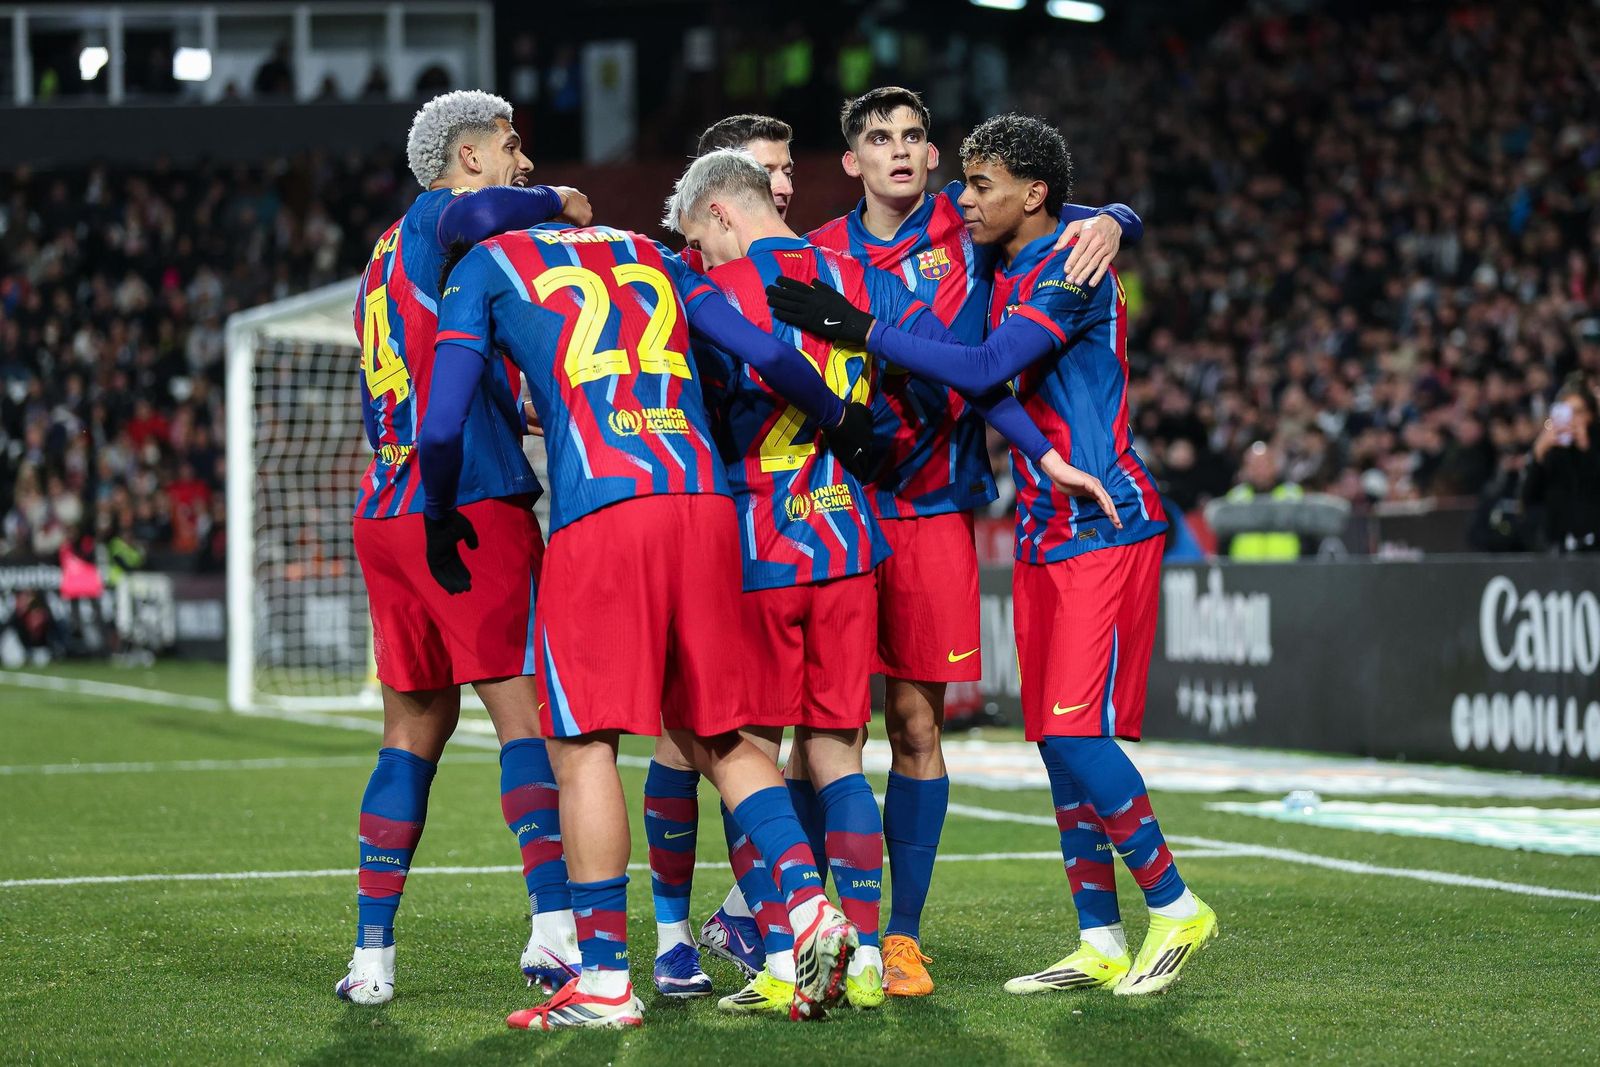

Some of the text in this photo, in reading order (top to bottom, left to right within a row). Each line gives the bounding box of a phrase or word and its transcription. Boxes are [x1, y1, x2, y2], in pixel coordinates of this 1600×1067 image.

[533, 264, 692, 388] 22
[364, 284, 409, 404] 4
[642, 408, 686, 419] UNHCR
[646, 419, 688, 430] ACNUR
[810, 484, 850, 501] UNHCR
[813, 494, 853, 511] ACNUR
